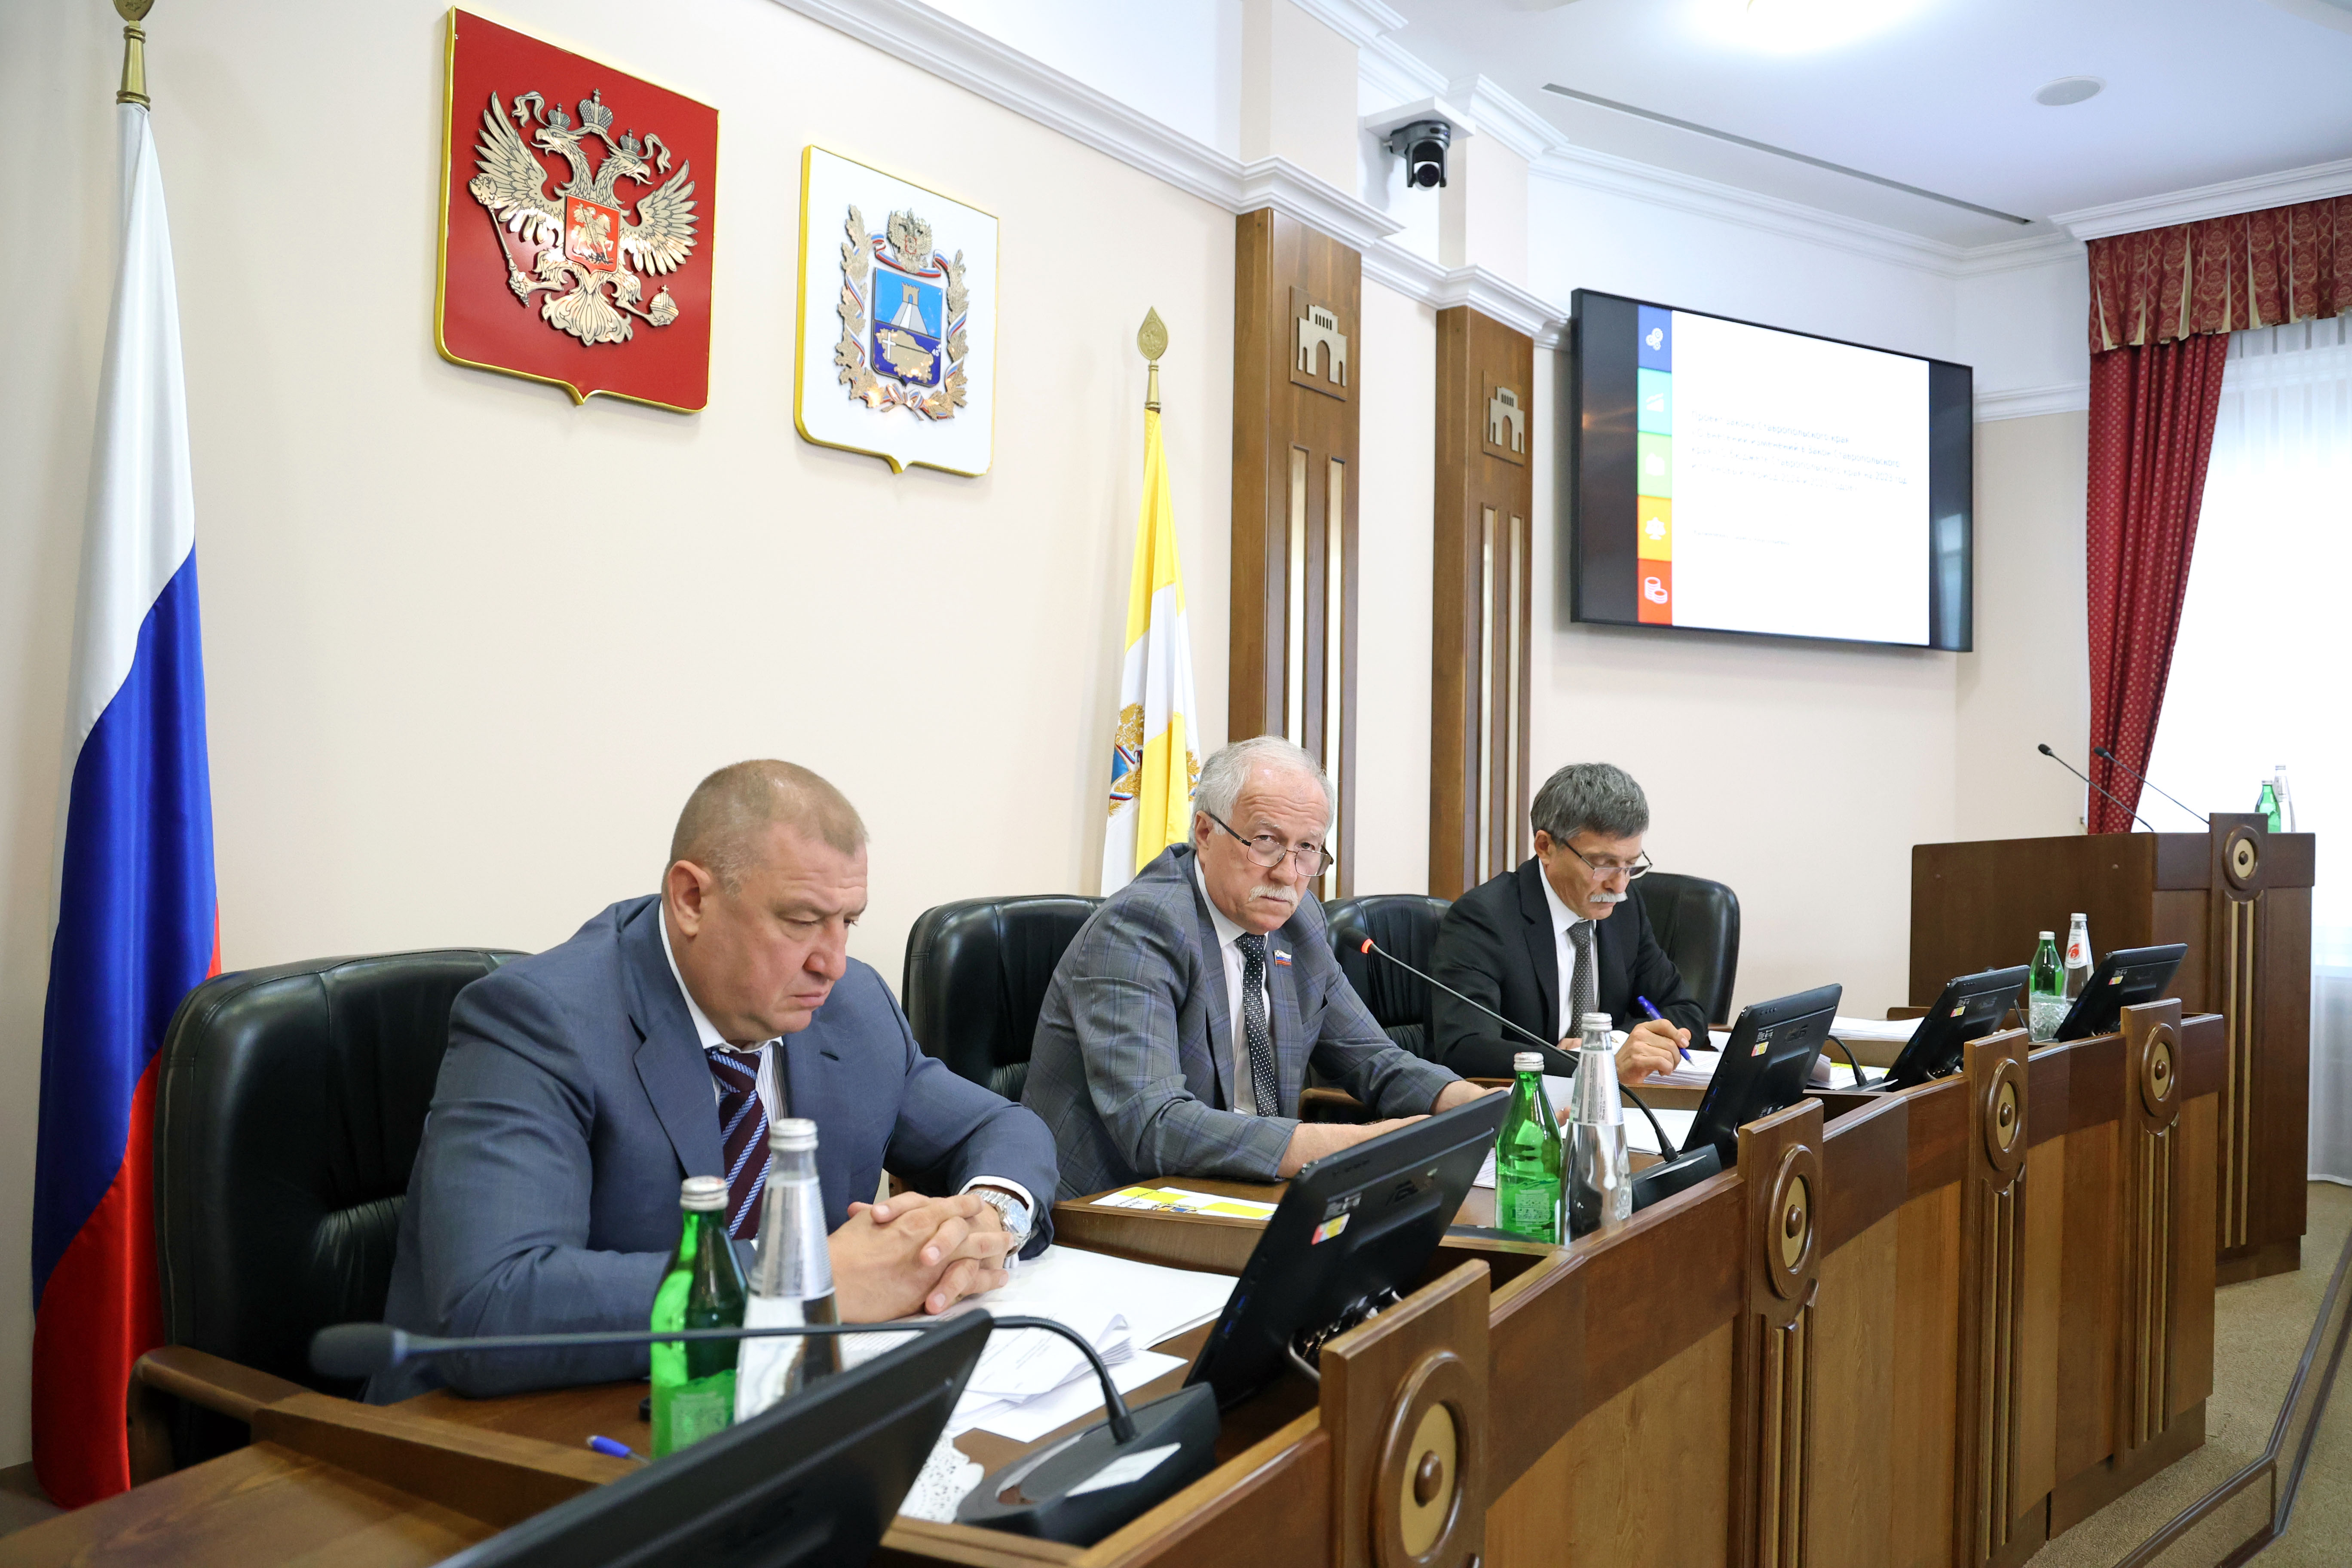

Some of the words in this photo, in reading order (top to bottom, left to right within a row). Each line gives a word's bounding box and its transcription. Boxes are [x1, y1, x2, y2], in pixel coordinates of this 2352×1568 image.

[1726, 420, 1755, 429] закона
[1758, 421, 1828, 440] Ставропольского
[1831, 435, 1850, 444] края
[1751, 440, 1798, 451] изменений
[1808, 445, 1831, 456] Закон
[1834, 449, 1900, 468] Ставропольского
[1875, 472, 1893, 482] 2023
